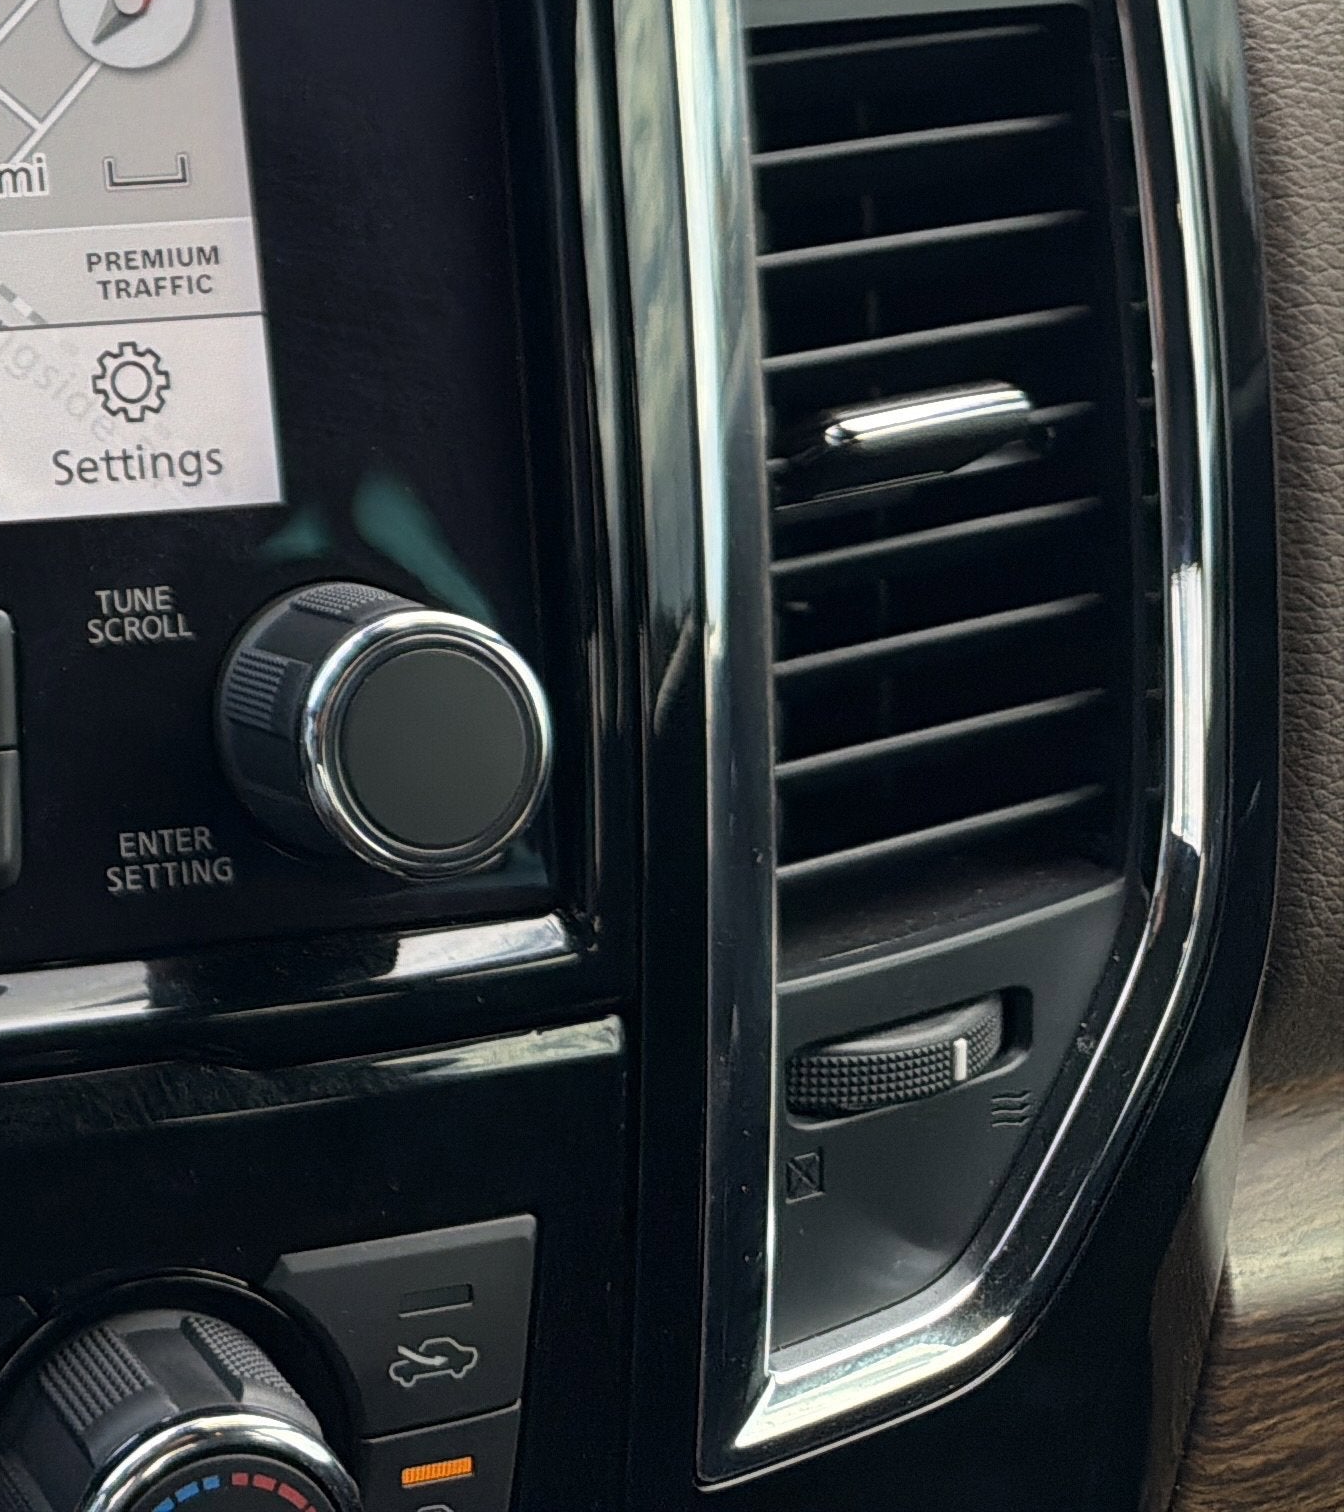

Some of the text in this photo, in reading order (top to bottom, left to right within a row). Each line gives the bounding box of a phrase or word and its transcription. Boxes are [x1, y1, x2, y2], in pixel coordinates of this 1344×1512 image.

[85, 245, 221, 274] PREMIUM
[95, 274, 214, 301] TRAFFIC
[52, 441, 224, 488] Settings
[93, 585, 174, 616] TUNE
[86, 609, 194, 645] SCROLL
[117, 825, 212, 861] ENTER
[105, 853, 234, 892] SETTING
